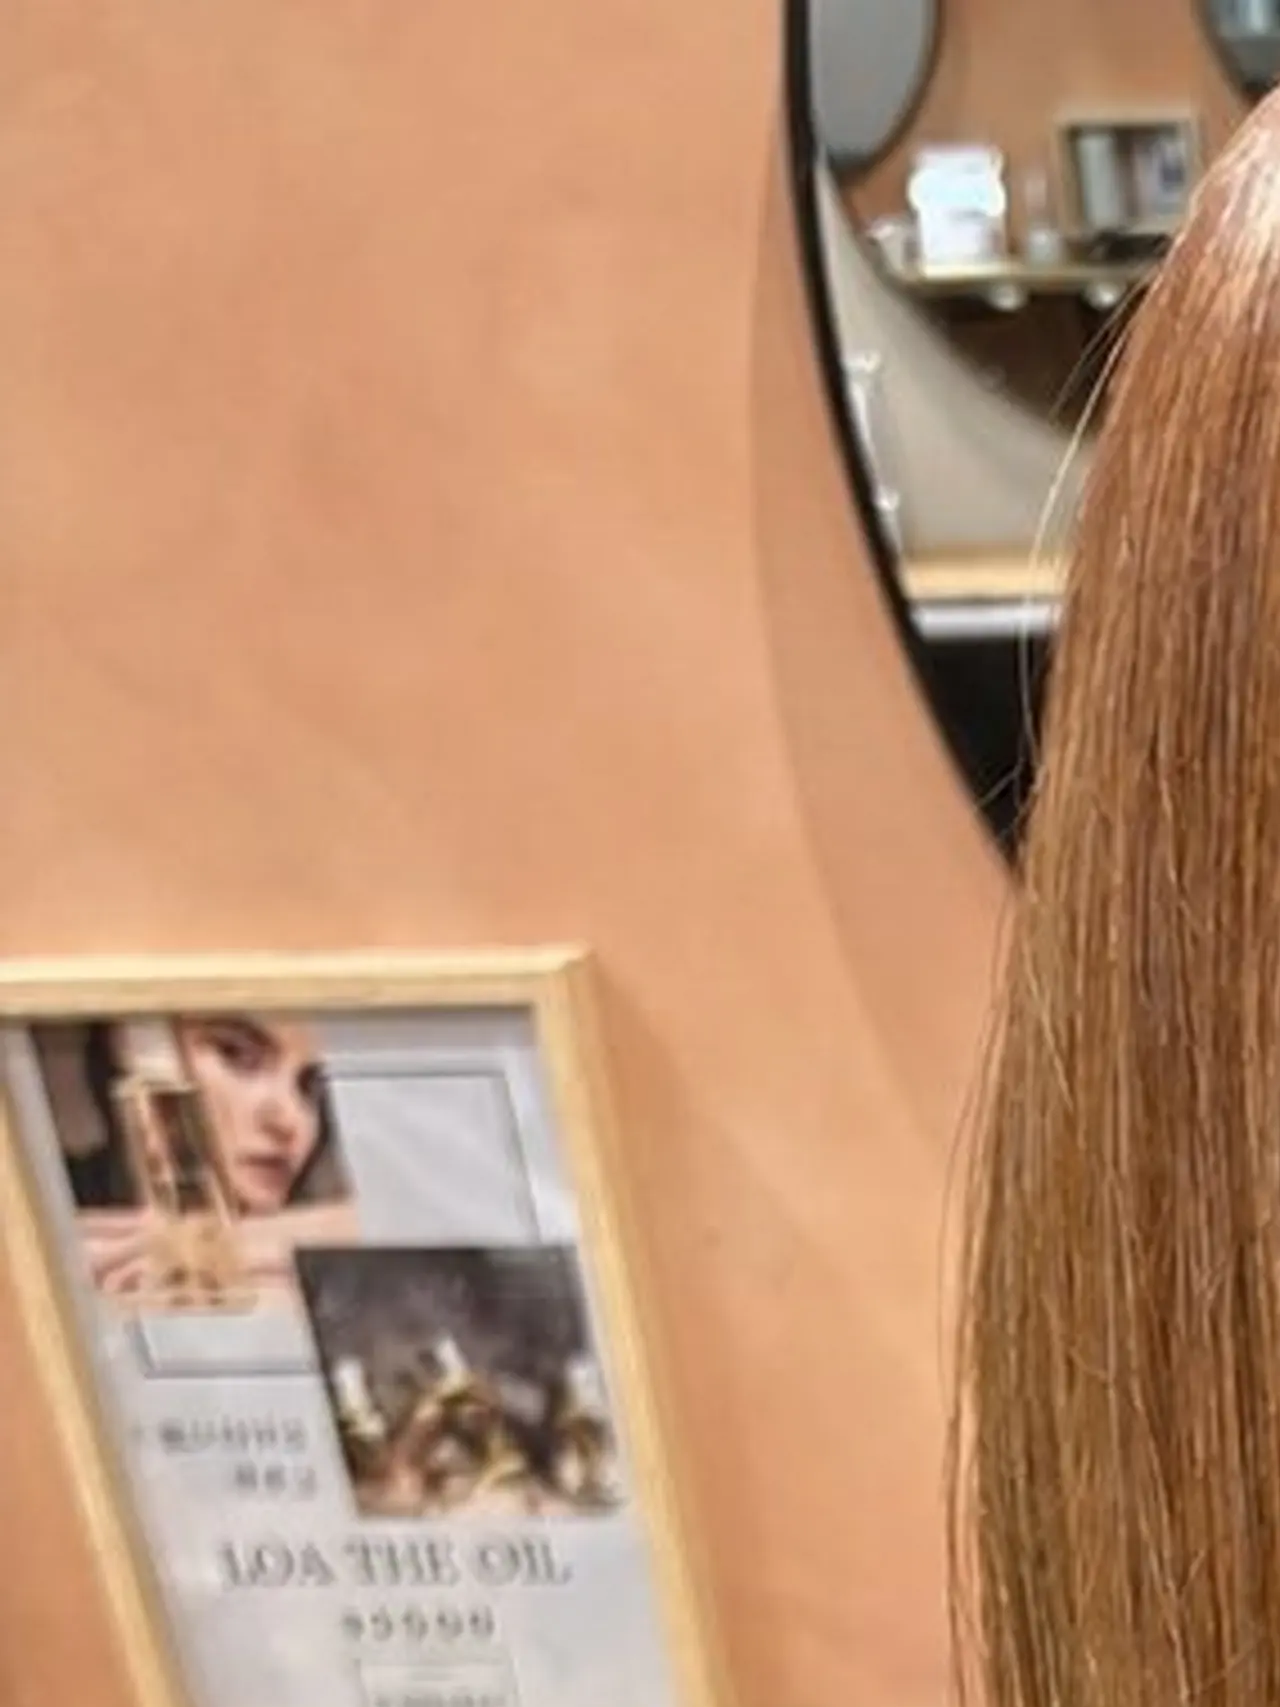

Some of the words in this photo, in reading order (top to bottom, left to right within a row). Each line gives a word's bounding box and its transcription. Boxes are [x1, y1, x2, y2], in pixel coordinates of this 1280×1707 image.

[221, 1539, 336, 1587] LOA
[343, 1537, 461, 1587] THE
[472, 1536, 575, 1587] OIL
